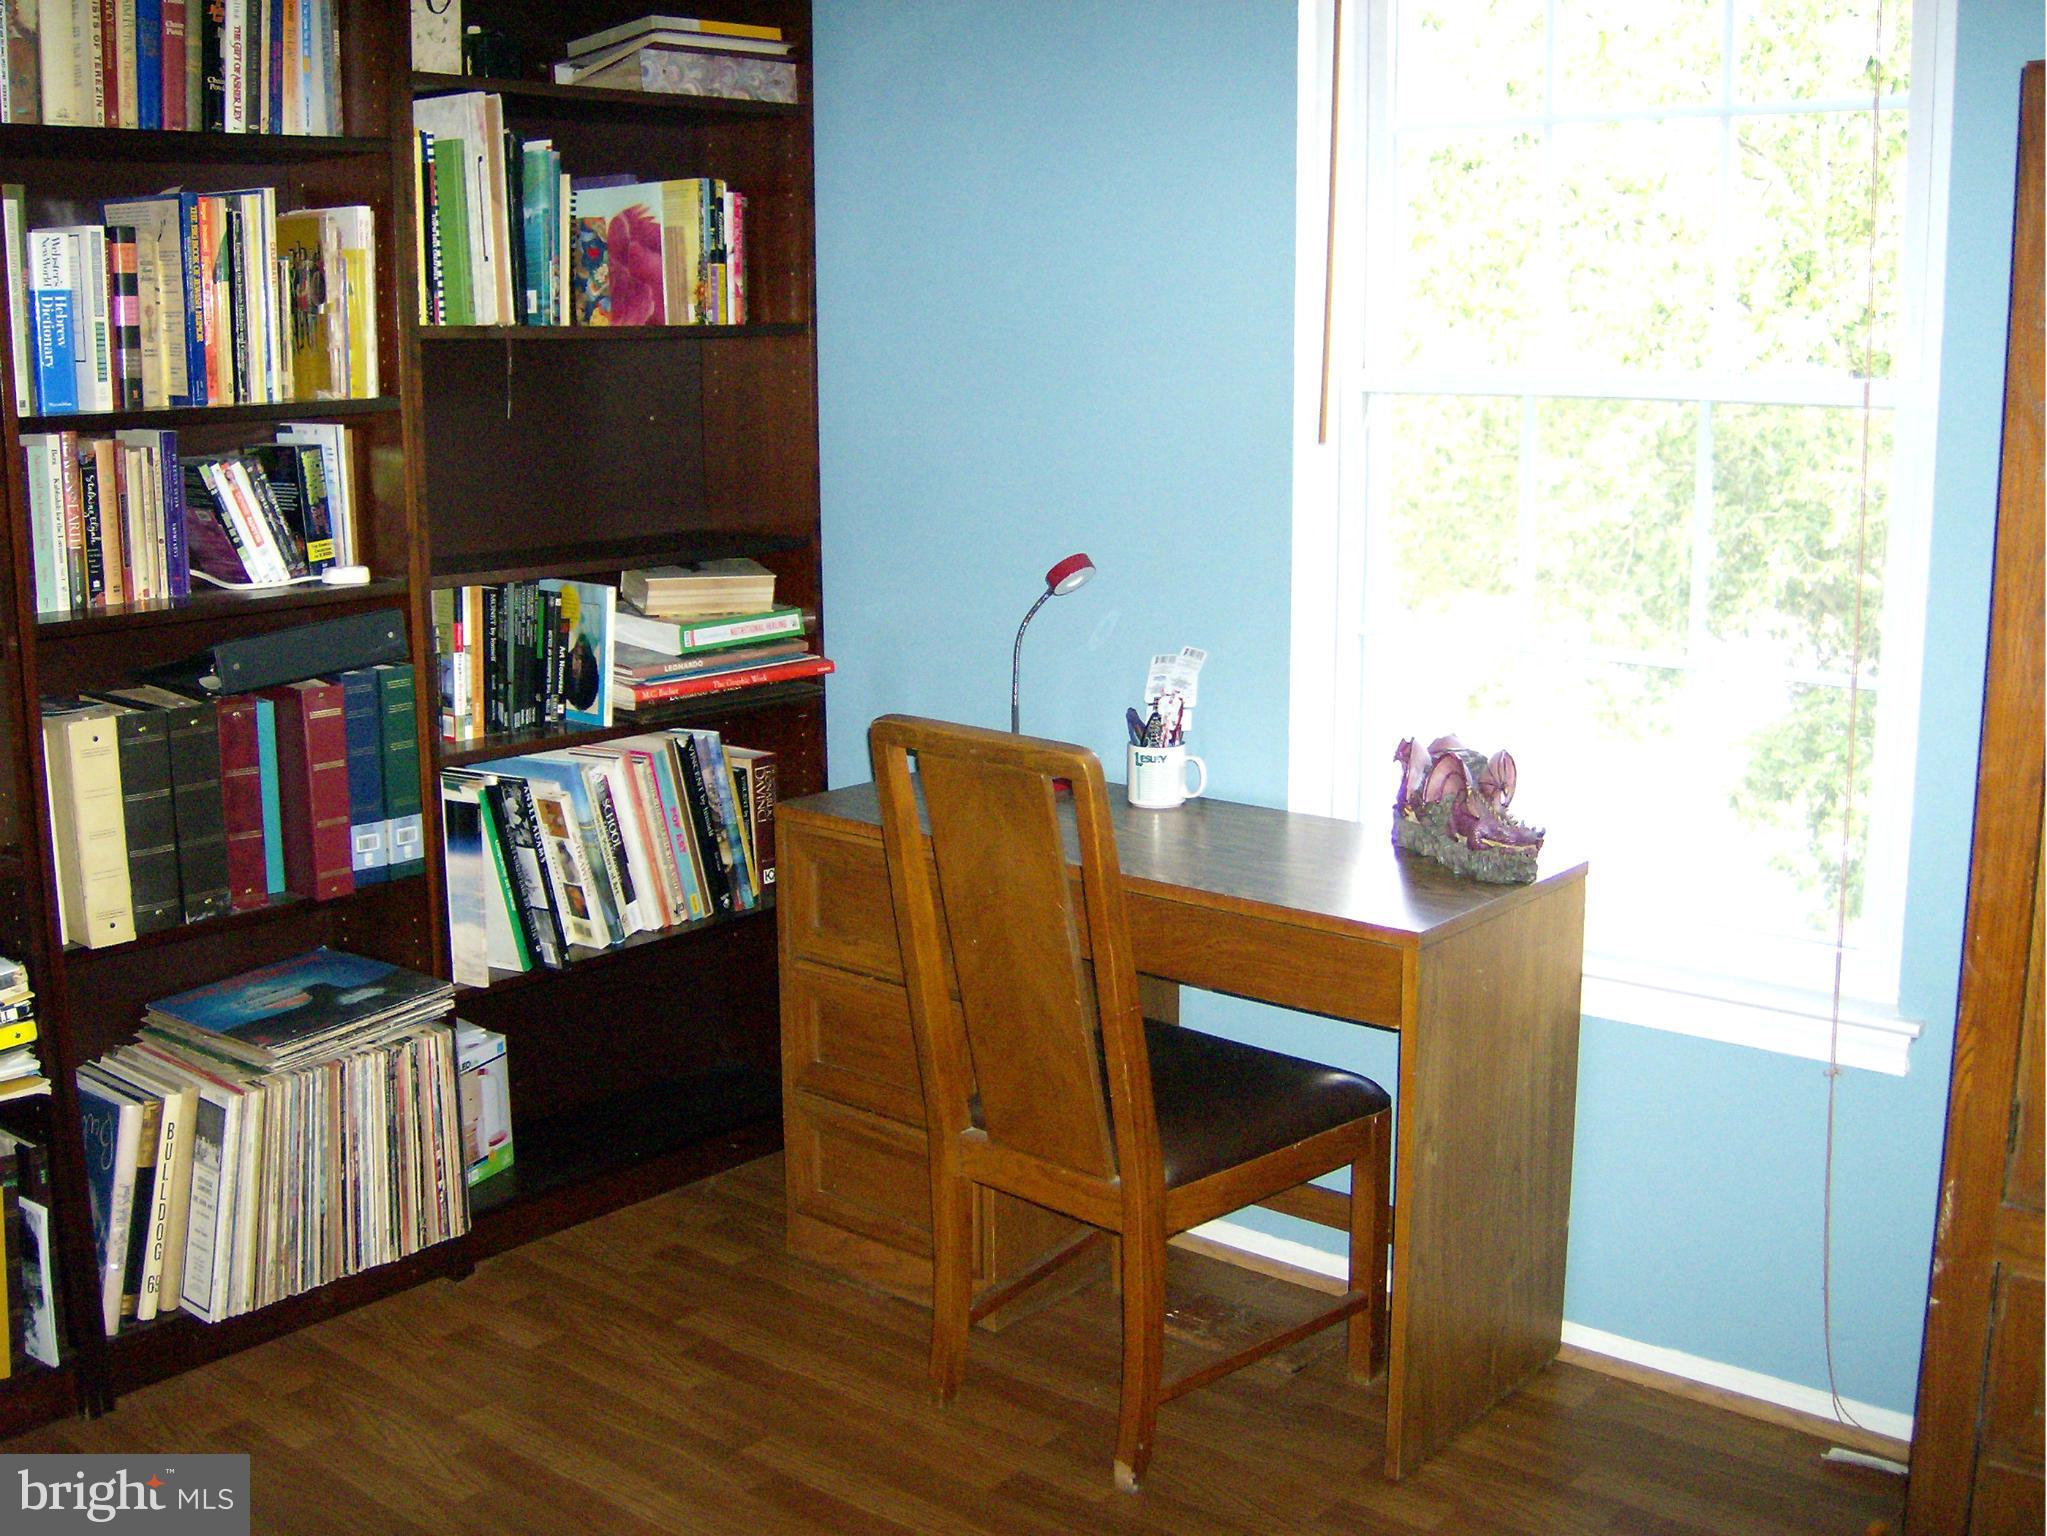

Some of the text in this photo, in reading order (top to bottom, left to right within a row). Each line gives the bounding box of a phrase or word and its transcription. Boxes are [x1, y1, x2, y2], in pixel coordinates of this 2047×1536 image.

[93, 35, 100, 50] OF
[94, 56, 103, 108] TEREZIN
[230, 25, 243, 122] THE GIFT OF ASHER LEV
[51, 236, 64, 287] Webster's
[189, 206, 205, 343] THE BIG BOOK OF JEWISH HUMOR
[40, 295, 56, 368] Dictionary
[54, 296, 68, 348] Hebrew
[67, 503, 82, 550] EARTH
[82, 474, 102, 546] Stalking Elijah
[558, 646, 566, 694] Art Nouveau
[664, 660, 704, 672] LEONARDO
[687, 743, 704, 794] VINCENT
[698, 794, 707, 805] by
[523, 785, 546, 864] ANSEL ADAMS
[602, 798, 622, 849] SCHOOL
[668, 805, 687, 854] POP ART
[153, 1121, 176, 1262] BULLDOG
